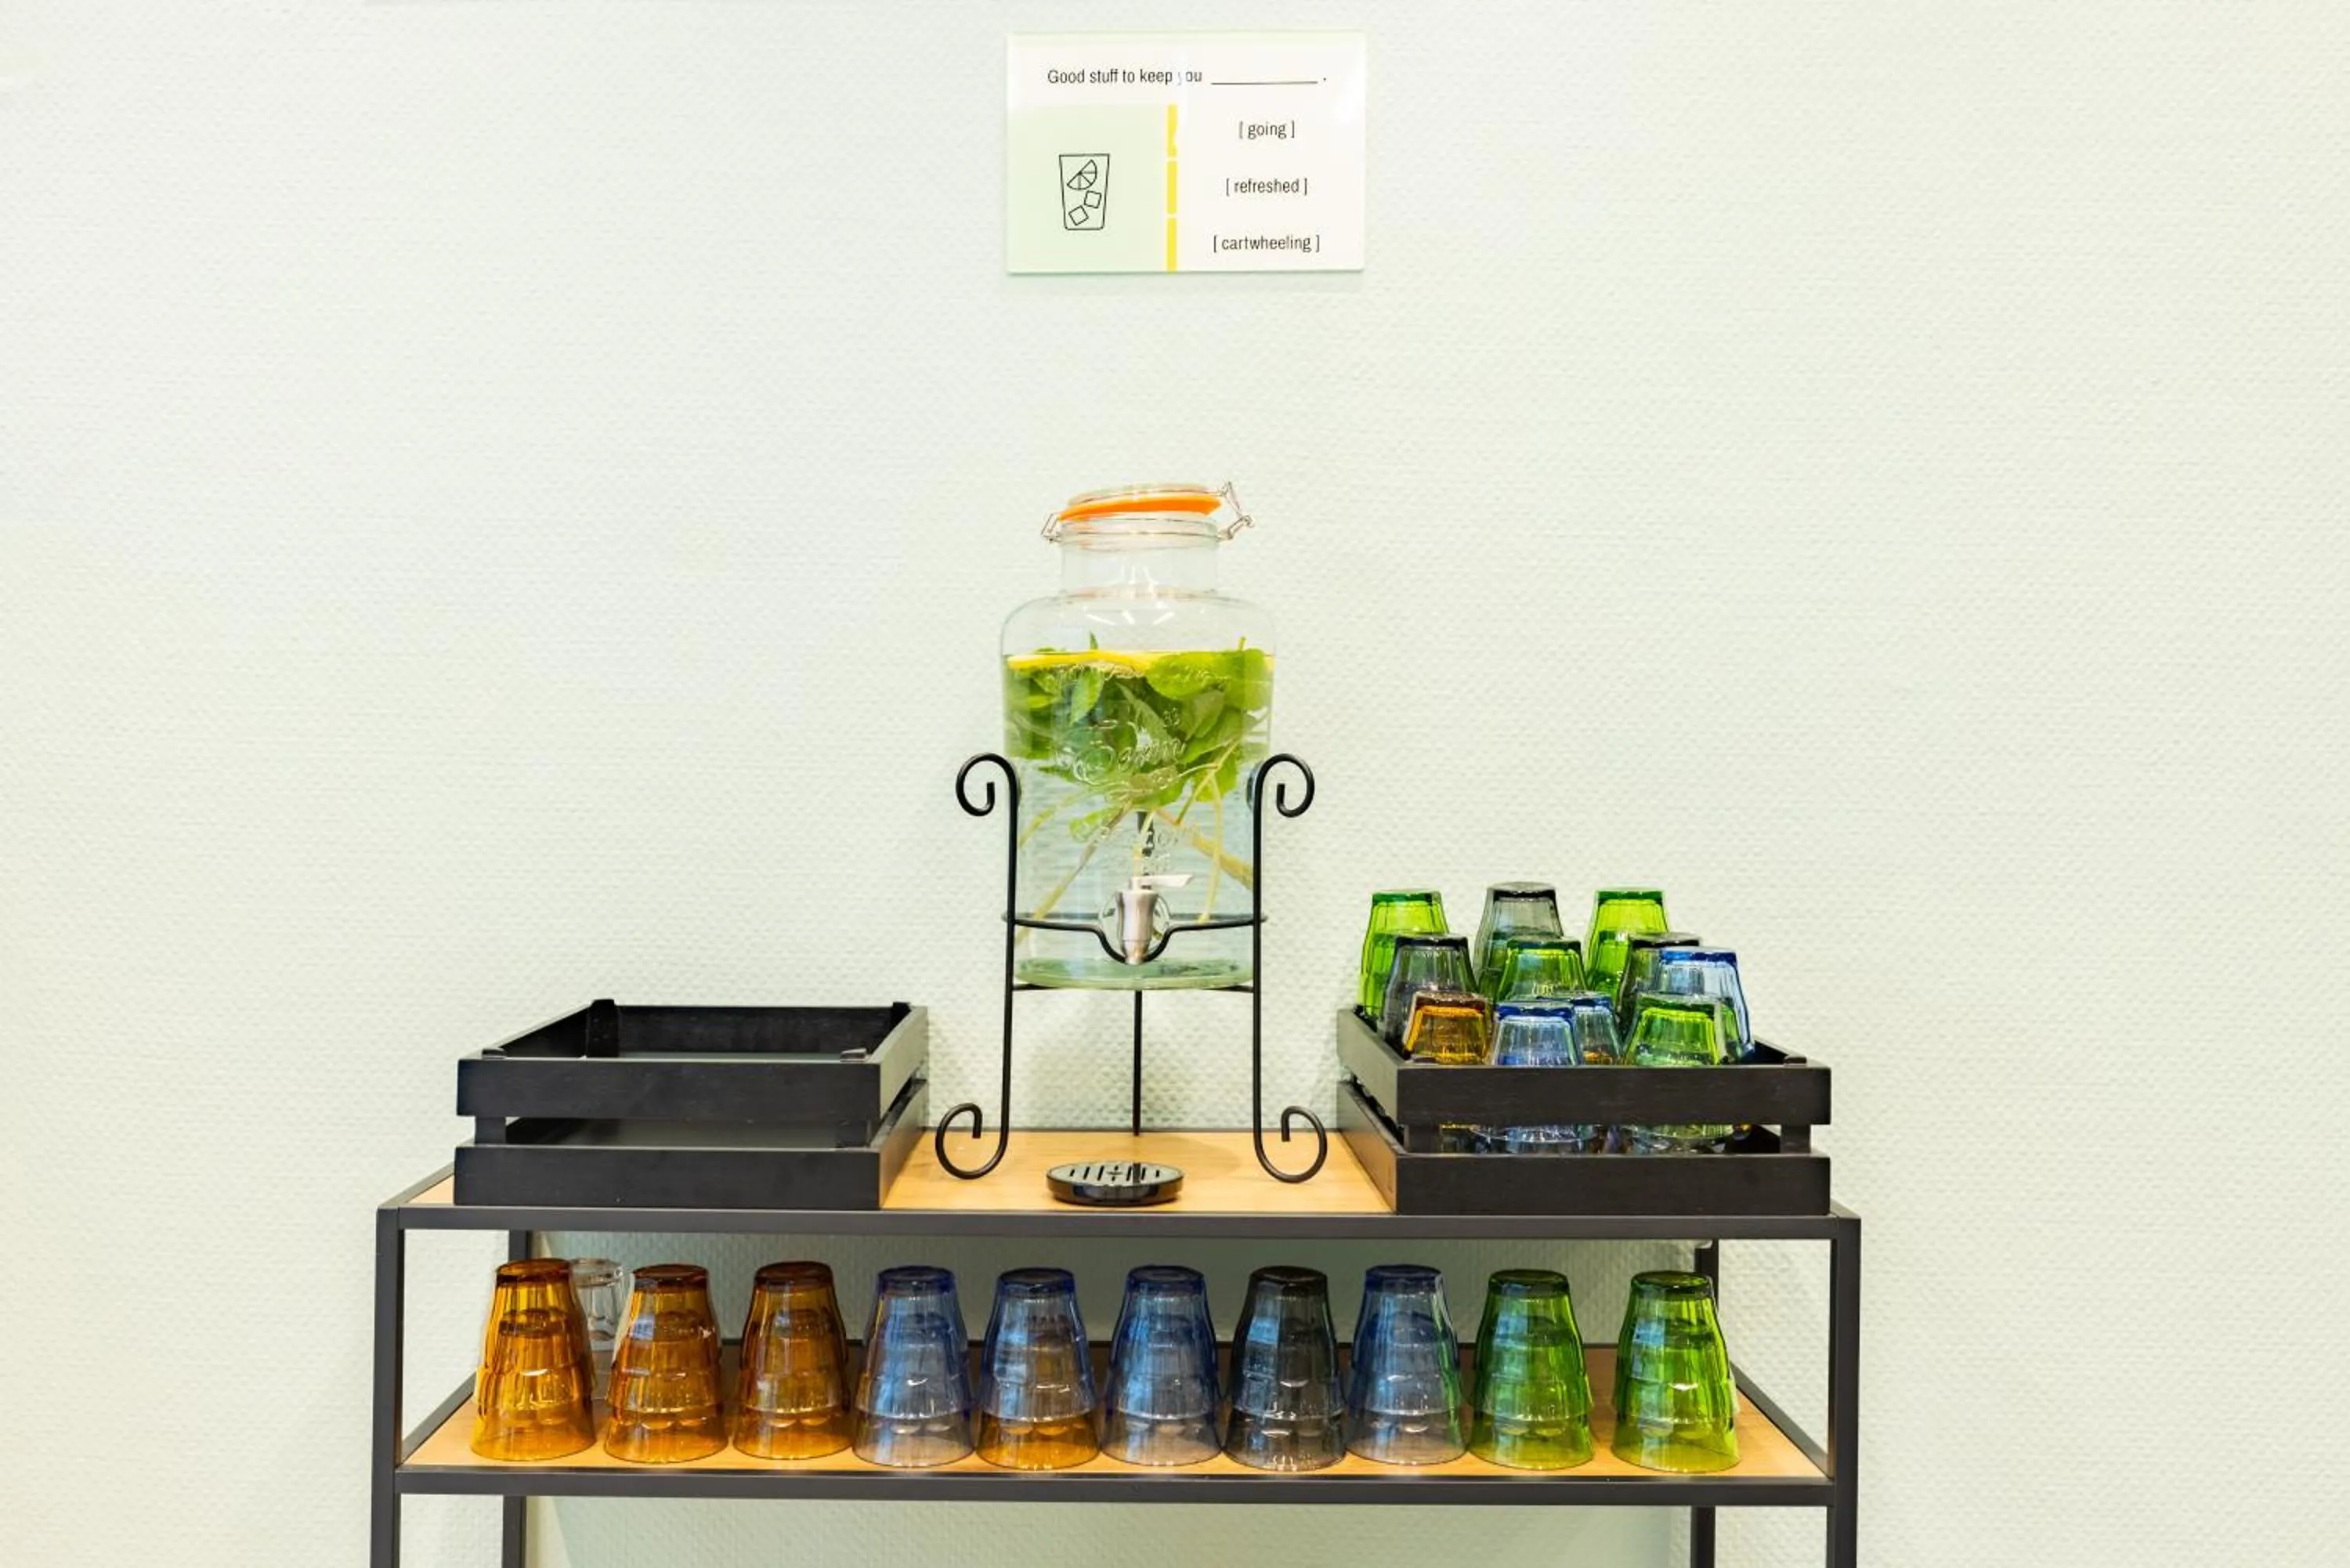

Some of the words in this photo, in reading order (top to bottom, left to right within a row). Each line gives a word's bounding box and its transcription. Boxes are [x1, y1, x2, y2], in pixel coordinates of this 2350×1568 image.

[1047, 68, 1086, 85] Good
[1089, 68, 1119, 84] stuff
[1121, 69, 1136, 84] to
[1140, 68, 1173, 86] keep
[1247, 121, 1288, 140] going
[1234, 178, 1300, 194] refreshed
[1221, 234, 1313, 254] cartwheeling
